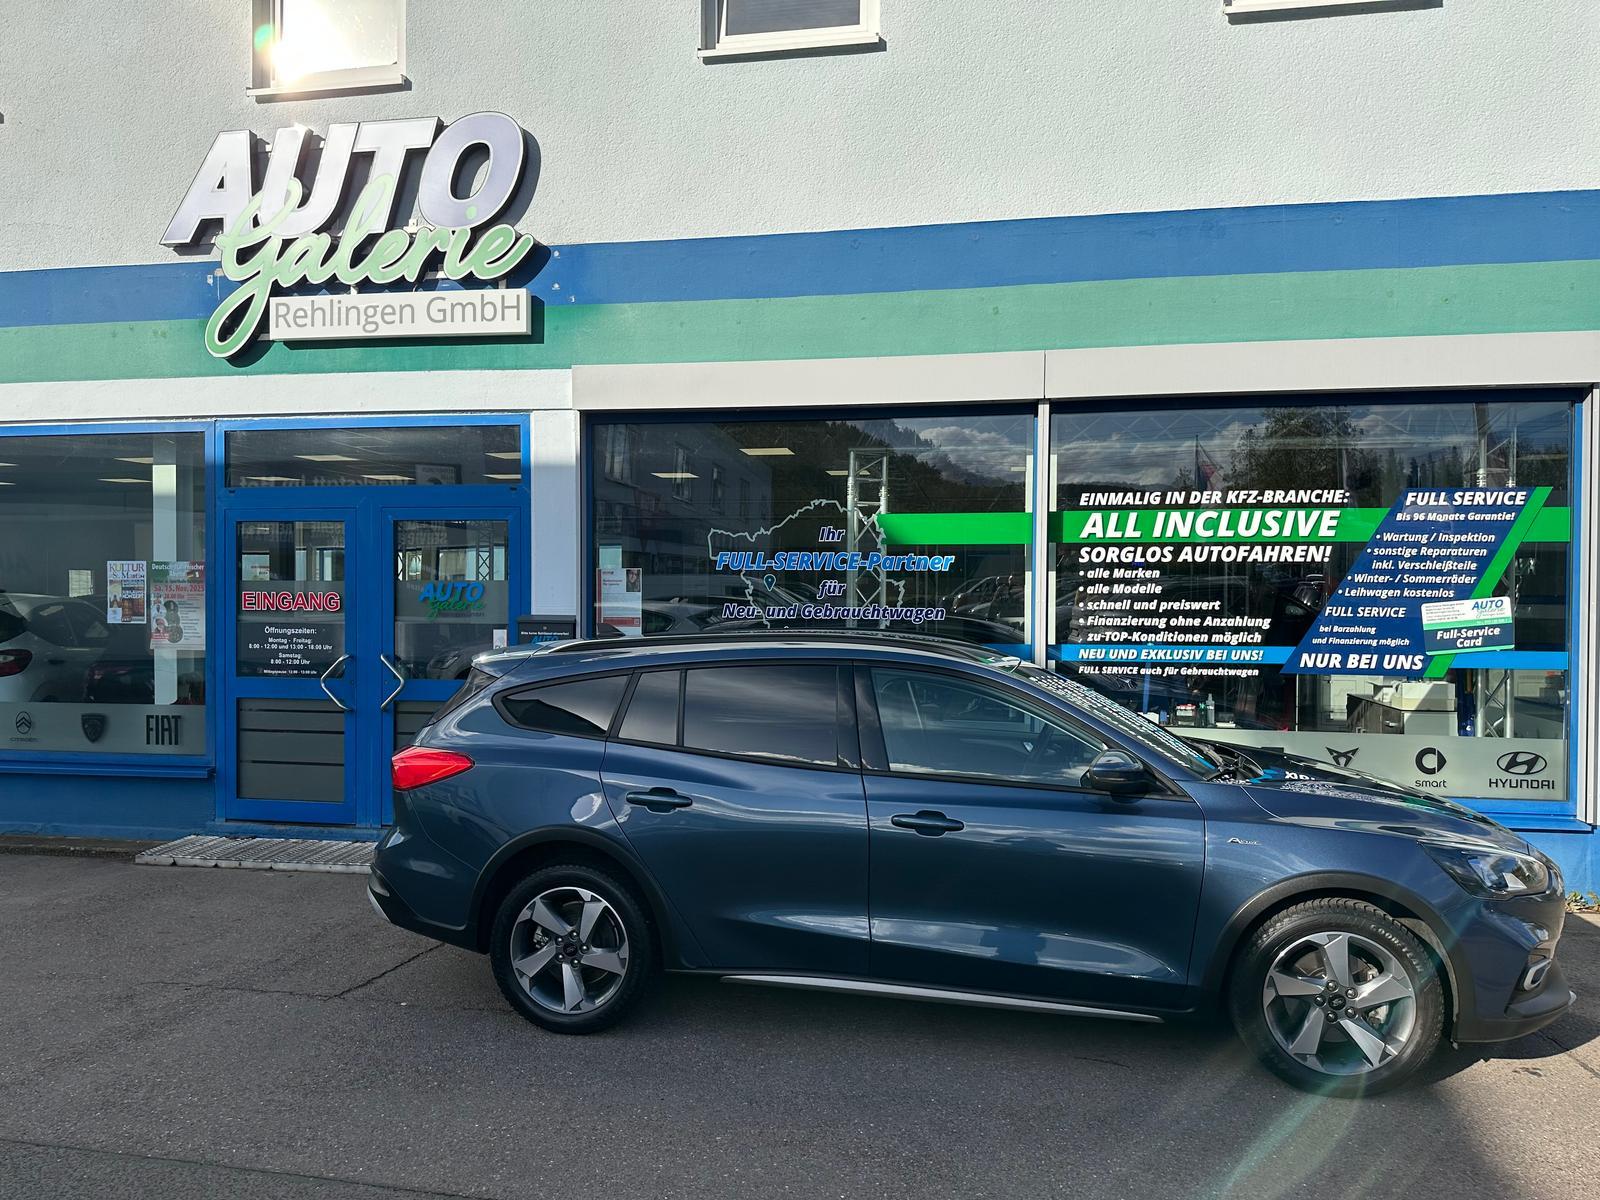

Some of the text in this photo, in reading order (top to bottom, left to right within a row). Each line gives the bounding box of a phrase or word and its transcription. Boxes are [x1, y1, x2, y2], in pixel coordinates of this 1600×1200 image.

[159, 110, 527, 246] AUTO
[205, 173, 535, 358] Galerie
[275, 294, 521, 334] Rehlingen GmbH
[1079, 489, 1351, 506] EINMALIG IN DER KFZ-BRANCHE:
[1405, 491, 1527, 506] FULL SERVICE
[1396, 512, 1516, 522] Bis 96 Monate Garantie!
[1079, 510, 1341, 538] ALL INCLUSIVE
[818, 526, 846, 542] Ihr
[1383, 532, 1429, 543] Wartung
[1438, 532, 1496, 544] Inspektion
[1078, 545, 1333, 563] SORGLOS AUTOFAHREN!
[1373, 546, 1488, 558] sonstige Reparaturen
[716, 551, 955, 572] FULL-SERVICE-Partner
[1372, 560, 1478, 571] inkl. Verschleißteile
[1087, 567, 1160, 579] alle Marken
[1354, 574, 1394, 583] Winter-
[1403, 573, 1477, 584] Sommerräder
[418, 581, 484, 602] AUTO
[817, 580, 847, 599] für
[1087, 583, 1162, 594] alle Modelle
[1345, 587, 1455, 599] Leihwagen kostenlos
[241, 591, 341, 611] EINGANG
[1087, 599, 1221, 612] schnell und preiswert
[1472, 599, 1504, 610] AUTO
[722, 603, 946, 622] Neu- und Gebrauchtwagen
[1325, 606, 1407, 618] FULL SERVICE
[1087, 615, 1271, 629] Finanzierung ohne Anzahlung
[264, 626, 317, 635] Öffnungszeiten:
[1319, 625, 1377, 634] bei Barzahlung
[1436, 627, 1501, 640] Full-Service
[1087, 631, 1262, 645] zu TOP-Konditionen möglich
[1328, 637, 1378, 646] Finanzierung
[1379, 637, 1410, 647] möglich
[1456, 637, 1483, 648] Card
[1079, 648, 1263, 661] NEU UND EXKLUSIV BEI UNS!
[1300, 653, 1425, 670] NUR BEI UNS
[1079, 666, 1259, 678] FULL SERVICE auch für Gebrauchtwagen
[145, 714, 182, 745] FIAT
[1414, 779, 1447, 788] smart
[1488, 778, 1555, 790] HYUNDAI
